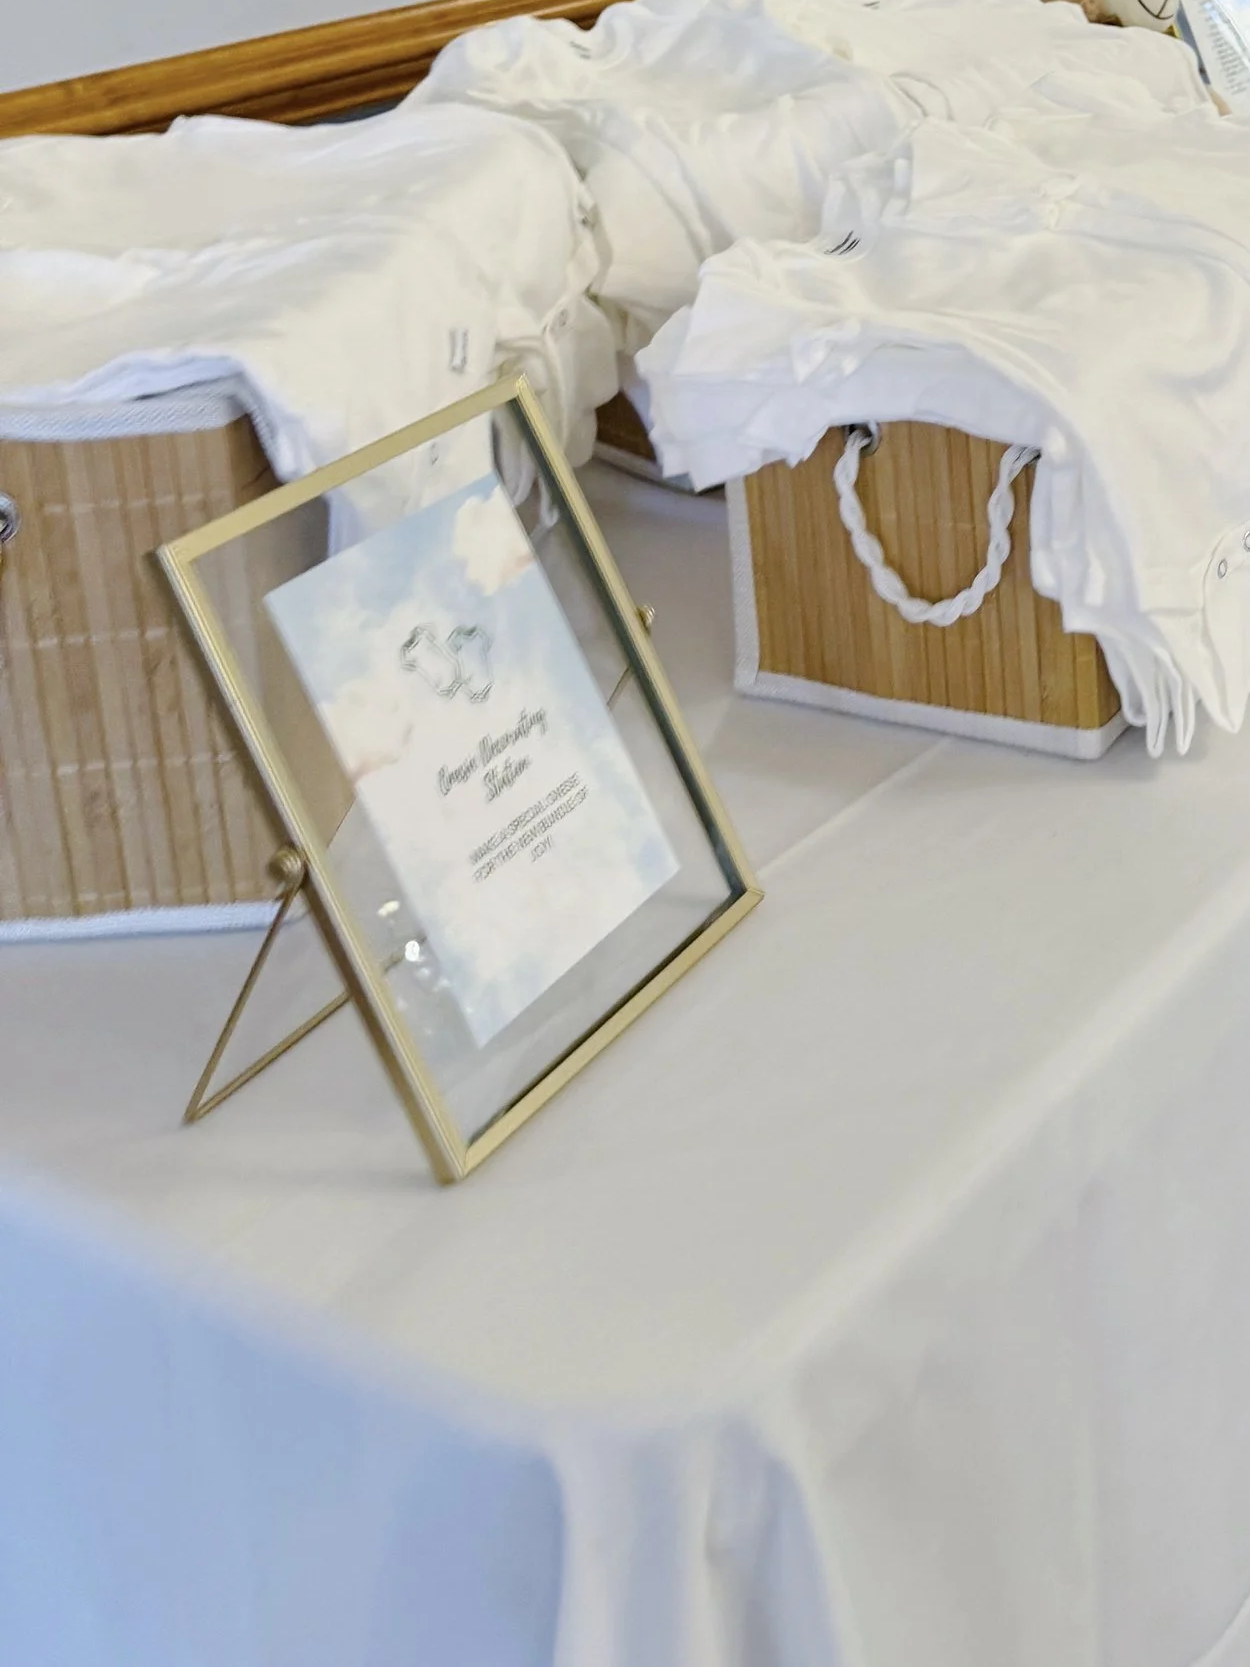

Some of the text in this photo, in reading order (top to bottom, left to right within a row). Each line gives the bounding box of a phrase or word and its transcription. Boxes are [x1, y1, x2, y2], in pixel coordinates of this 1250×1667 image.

[471, 833, 501, 864] MAKE
[507, 800, 546, 835] SPECIAL
[545, 772, 580, 804] ONESIE
[483, 756, 531, 802] Station
[474, 786, 587, 882] FOR THE NEW BUNDLE OF
